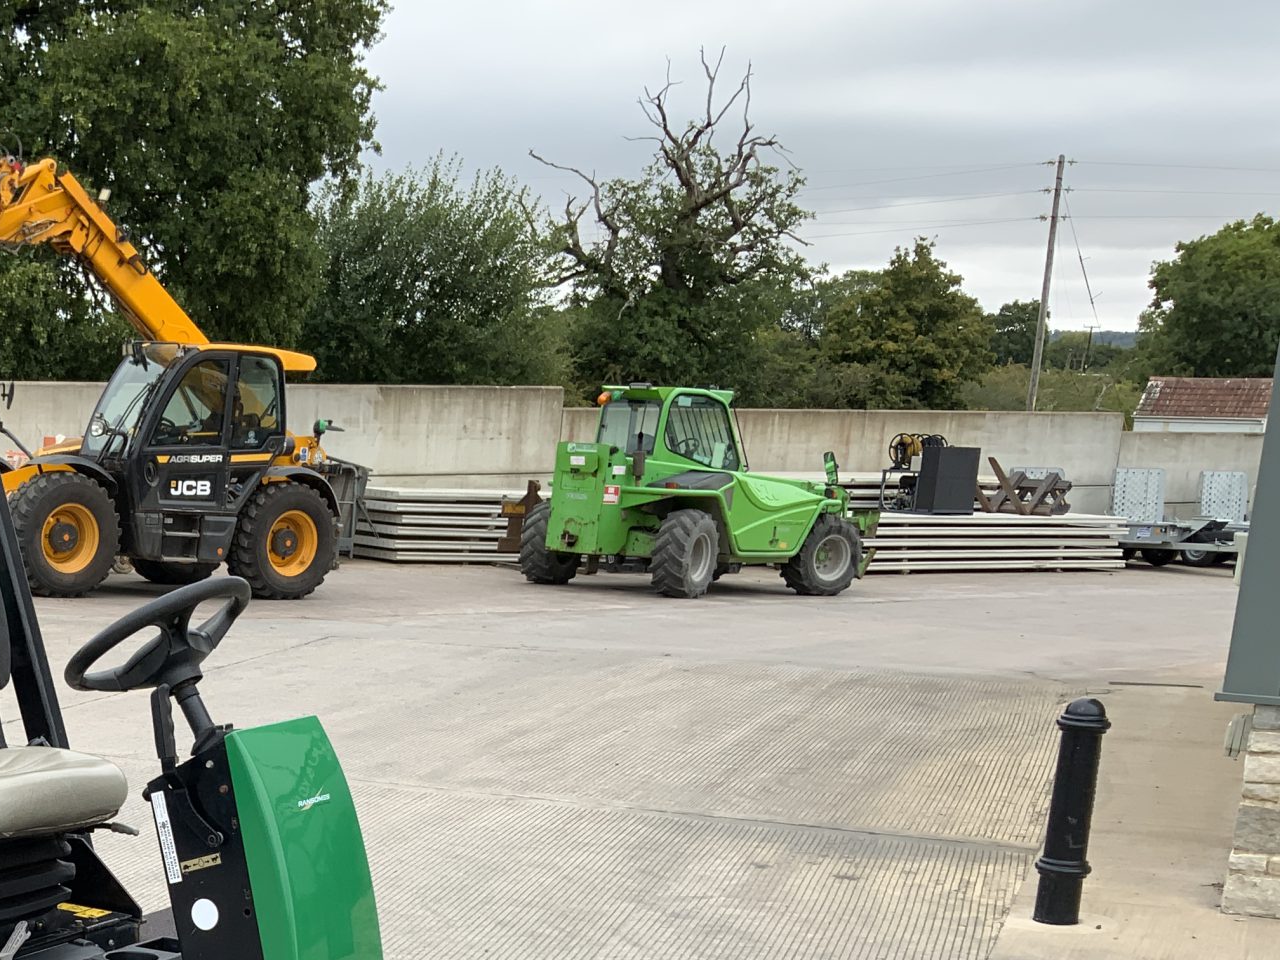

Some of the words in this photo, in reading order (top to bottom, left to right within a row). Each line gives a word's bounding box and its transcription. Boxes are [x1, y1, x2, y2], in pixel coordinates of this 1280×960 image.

[170, 454, 223, 463] AGRISUPER
[170, 480, 211, 496] JCB
[298, 793, 330, 808] RANSOMES
